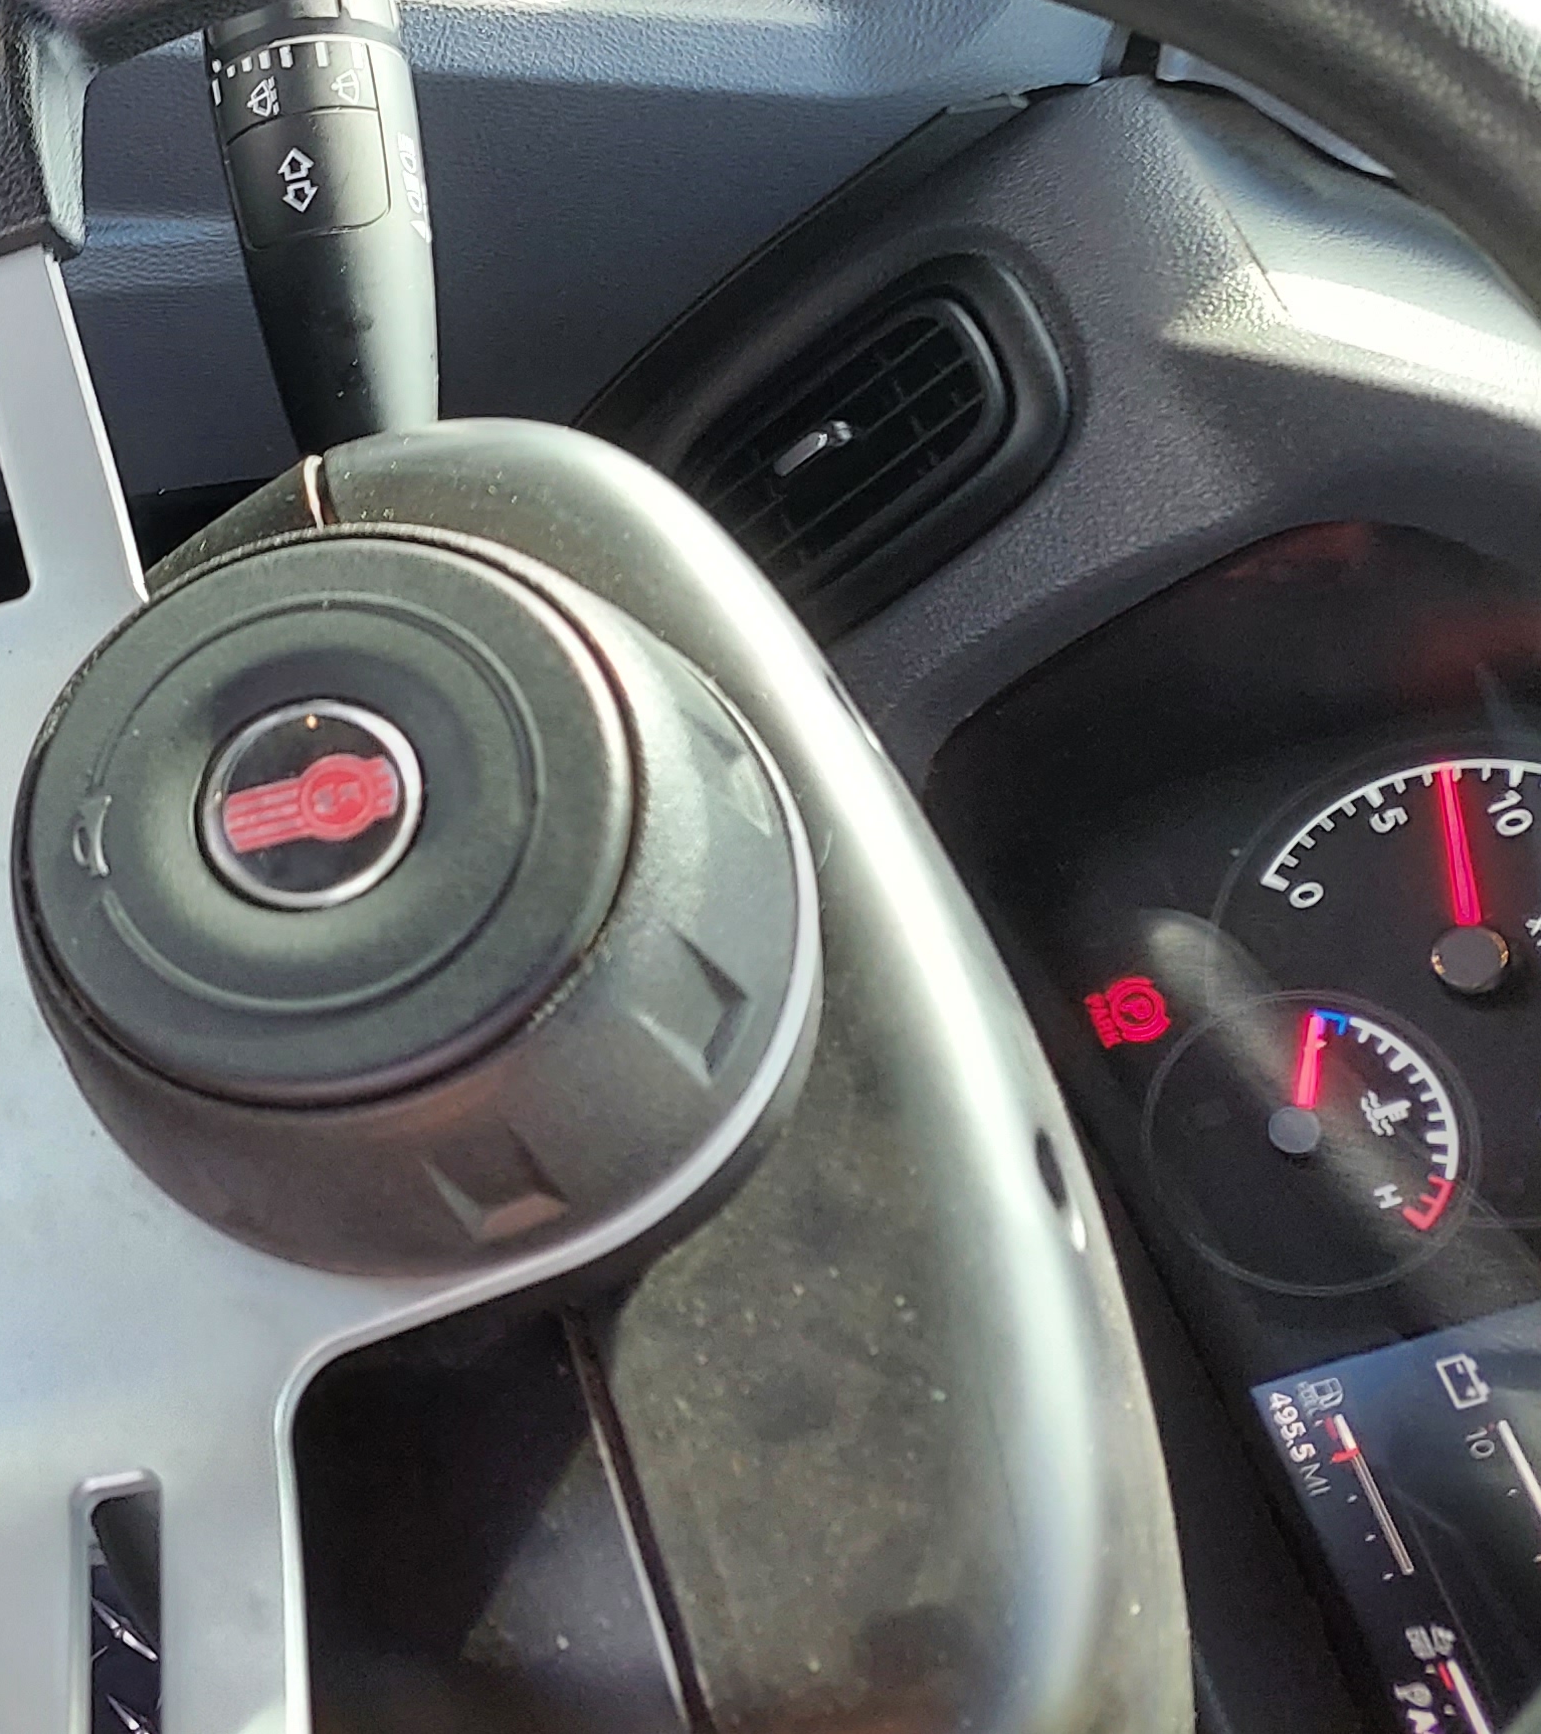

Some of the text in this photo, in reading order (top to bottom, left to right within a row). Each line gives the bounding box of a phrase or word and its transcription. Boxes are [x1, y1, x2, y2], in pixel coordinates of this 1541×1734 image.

[1369, 805, 1409, 835] 5
[1486, 789, 1534, 837] 10
[1288, 881, 1325, 910] 0
[1374, 1182, 1404, 1210] H
[1268, 1391, 1331, 1497] 495.5 MI
[1464, 1427, 1496, 1461] 10
